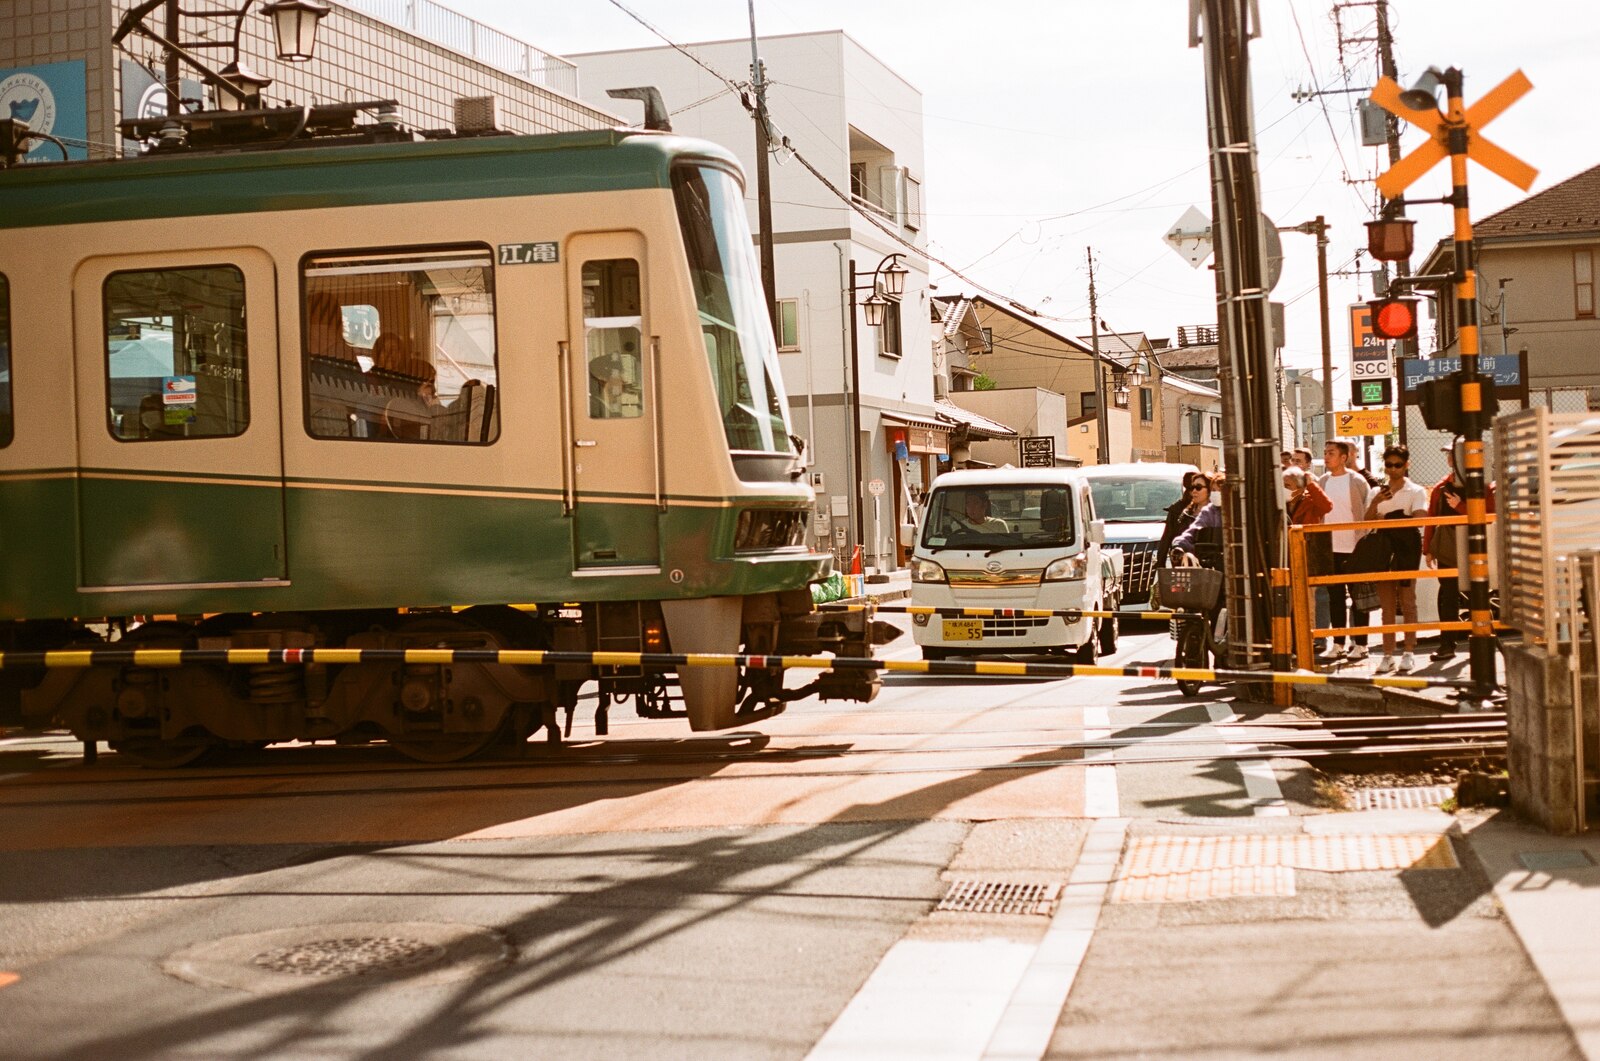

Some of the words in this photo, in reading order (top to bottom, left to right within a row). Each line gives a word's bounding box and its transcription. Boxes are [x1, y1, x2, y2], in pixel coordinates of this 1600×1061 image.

[0, 78, 45, 97] AMAKURA
[500, 243, 556, 264] 江ノ電
[1363, 336, 1385, 347] 24H
[1355, 362, 1387, 375] SCC
[1362, 384, 1382, 402] 空
[1366, 422, 1379, 430] OK
[967, 628, 981, 639] 55
